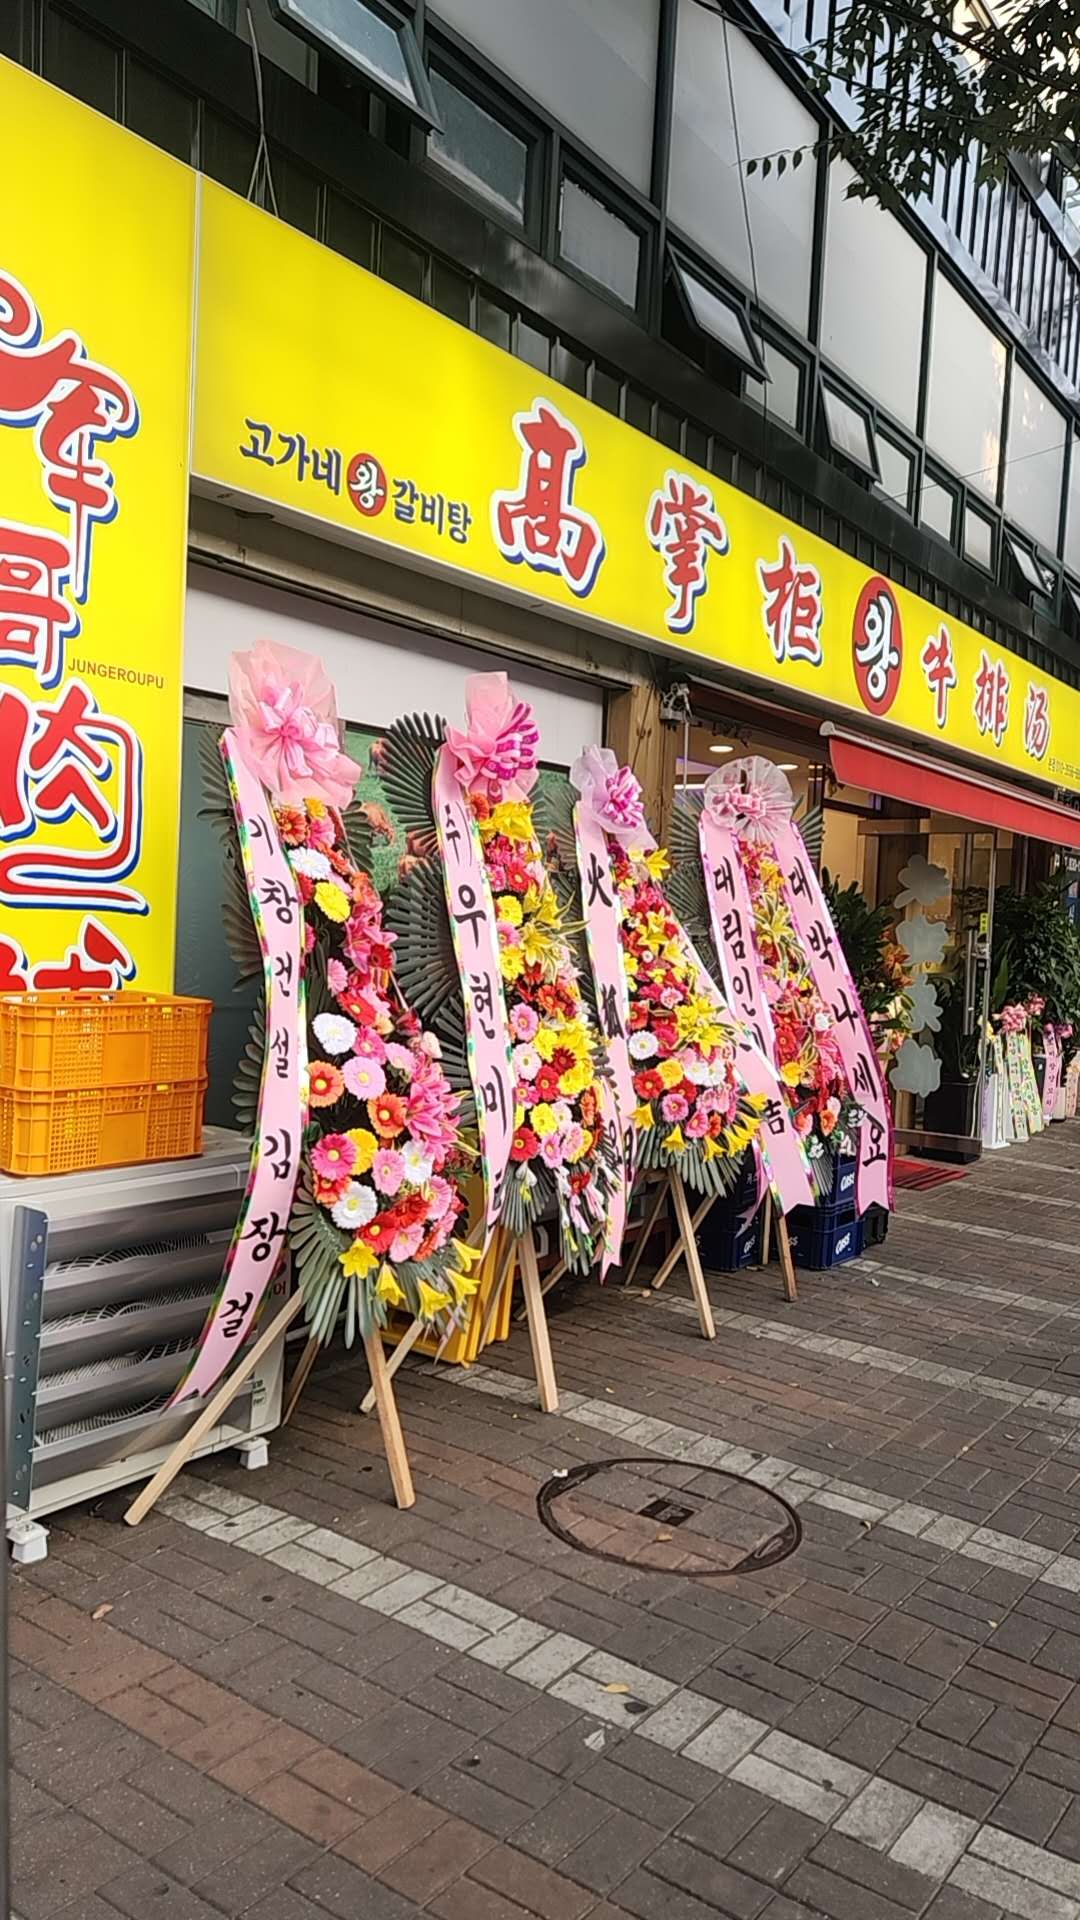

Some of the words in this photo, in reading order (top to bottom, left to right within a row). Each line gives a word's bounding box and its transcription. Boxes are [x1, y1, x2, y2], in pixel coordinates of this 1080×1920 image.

[239, 418, 341, 496] 고가네
[349, 459, 386, 512] 왕
[392, 478, 473, 544] 갈비탕
[68, 658, 164, 689] JUNGEROUPU
[854, 590, 900, 701] 왕
[787, 856, 887, 1168] 대박나세요
[219, 1128, 292, 1338] 김장걸
